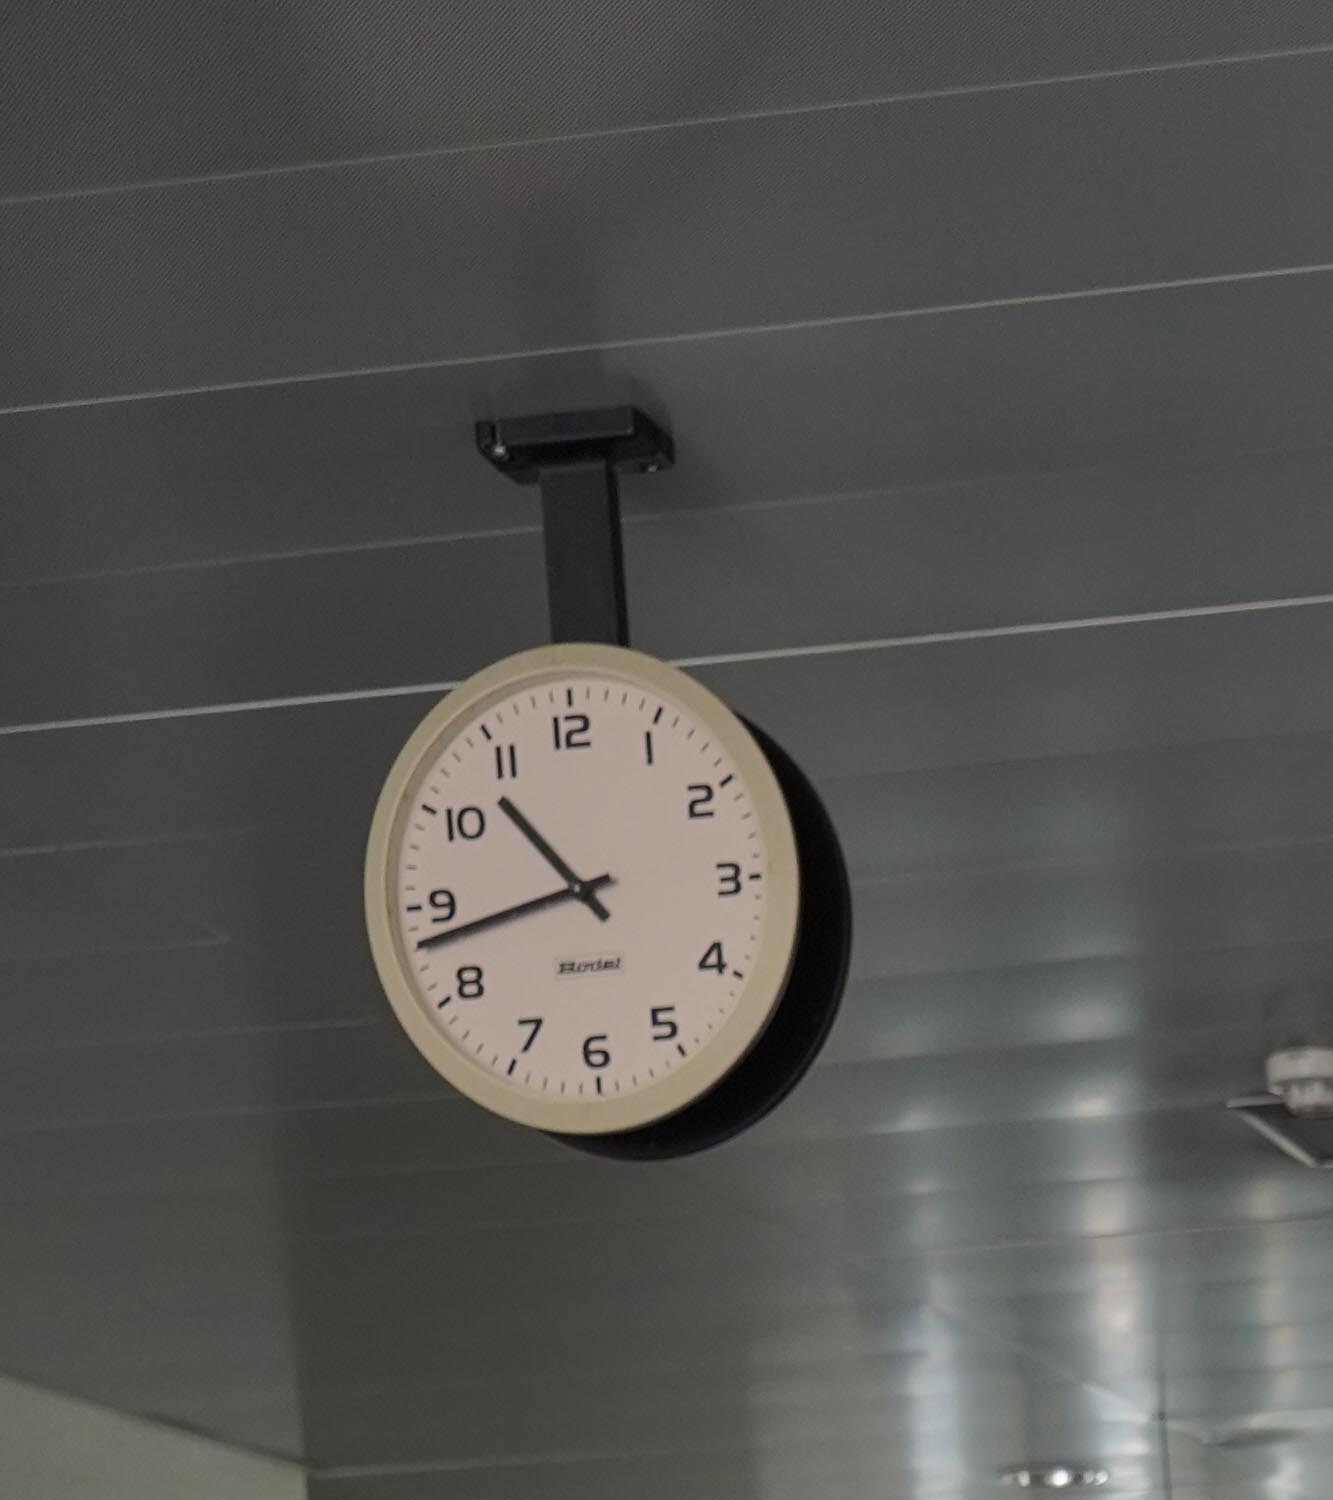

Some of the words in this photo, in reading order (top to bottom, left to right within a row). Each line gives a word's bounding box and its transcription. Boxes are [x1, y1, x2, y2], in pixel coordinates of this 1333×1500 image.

[552, 715, 591, 750] 12
[646, 731, 653, 766] 1
[496, 744, 516, 779] 11
[688, 785, 715, 818] 2
[445, 807, 486, 841] 10
[716, 863, 742, 897] 3
[429, 890, 456, 923] 9
[698, 942, 727, 975] 4
[457, 966, 484, 999] 8
[518, 1018, 543, 1053] 7
[651, 1006, 678, 1041] 5
[583, 1036, 610, 1068] 6
